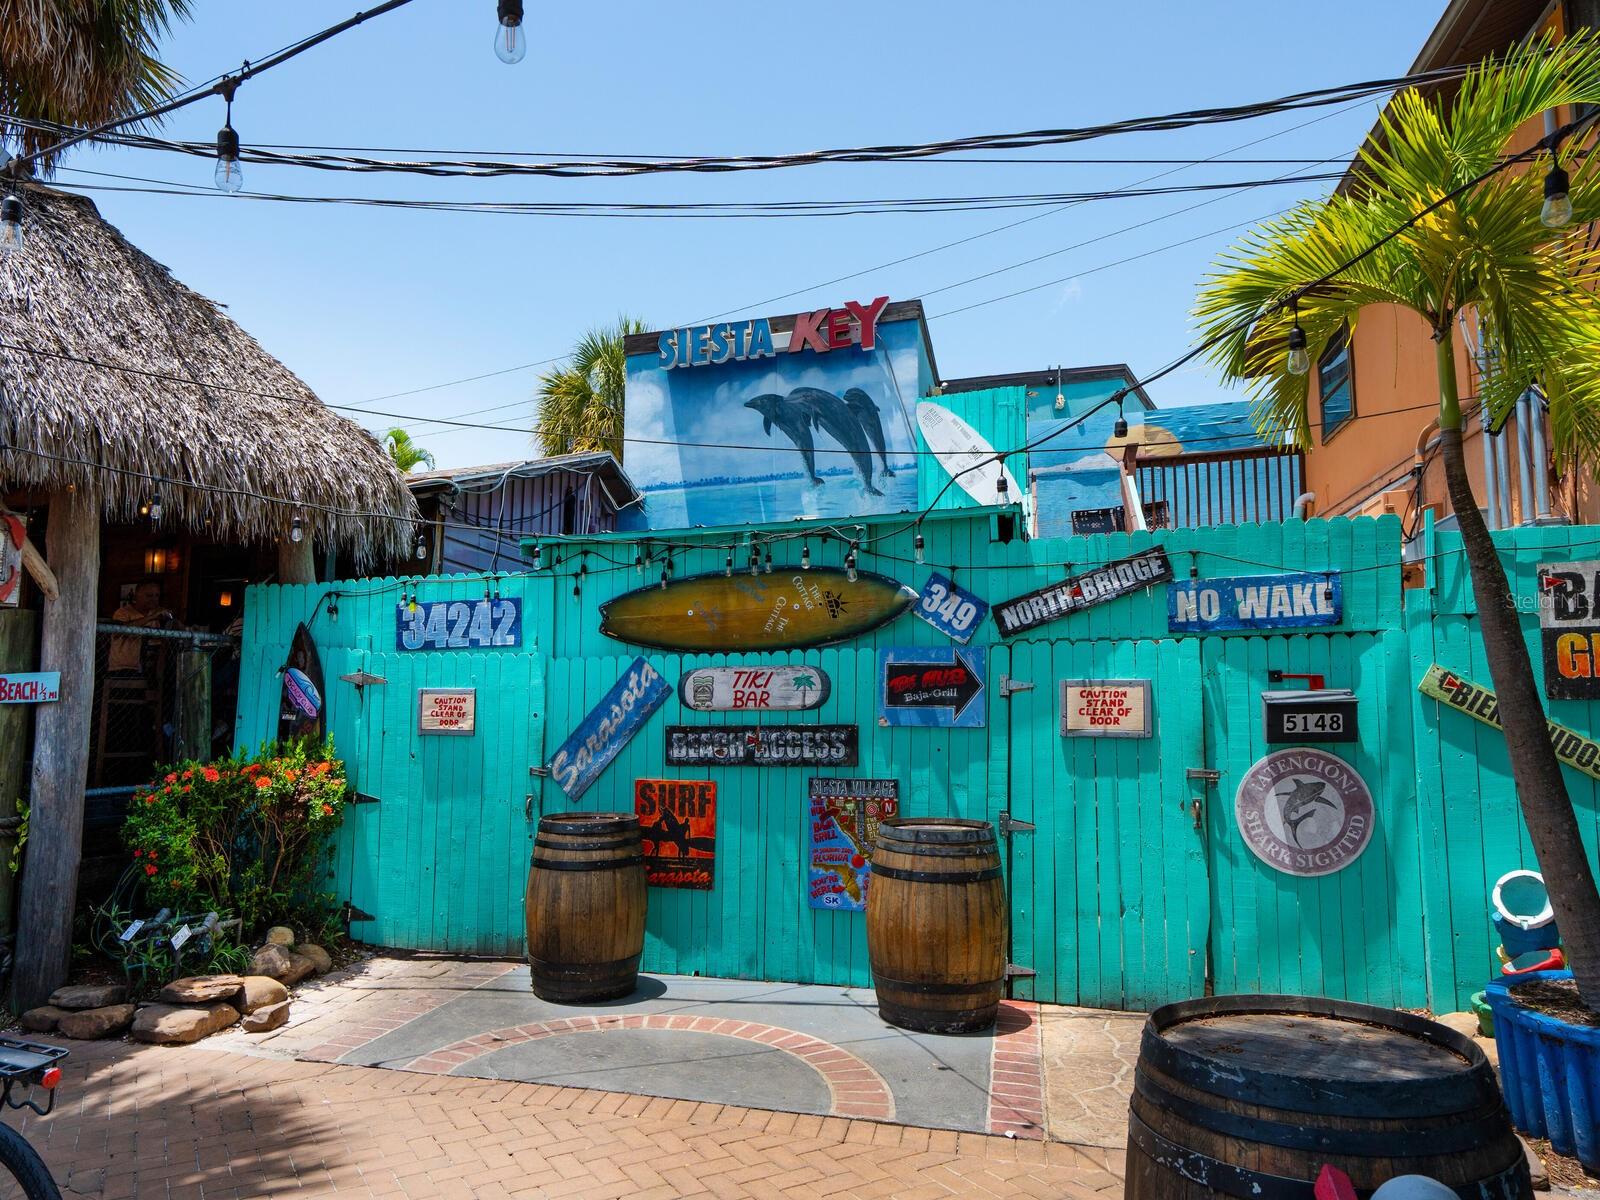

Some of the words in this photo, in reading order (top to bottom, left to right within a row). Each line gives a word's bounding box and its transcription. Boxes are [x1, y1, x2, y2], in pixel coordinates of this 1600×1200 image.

[658, 316, 776, 370] SIESTA
[787, 295, 890, 353] KEY
[792, 575, 815, 611] COTTAGE
[808, 582, 822, 602] THE
[1001, 585, 1072, 631] NORTH
[1082, 551, 1167, 602] BRIDGE
[1552, 571, 1600, 621] B
[921, 583, 977, 631] 349
[1176, 588, 1221, 624] NO
[1237, 581, 1335, 620] WAKE
[763, 596, 787, 633] COTTAGE
[402, 600, 517, 650] 34242
[775, 616, 790, 633] THE
[1556, 632, 1600, 679] G
[732, 671, 775, 689] TIKI
[922, 668, 968, 687] HUB
[0, 677, 38, 700] BEACH
[904, 687, 959, 703] Baja-Grill
[1079, 689, 1128, 699] CAUTION
[434, 696, 467, 705] CAUTION
[438, 704, 463, 712] STAND
[732, 690, 771, 708] BAR
[1086, 699, 1125, 708] STAND
[430, 710, 455, 718] CLEAR
[456, 711, 467, 719] OF
[1078, 707, 1114, 716] CLEAR
[1116, 707, 1133, 717] OF
[1089, 716, 1121, 726] DOOR
[439, 719, 459, 727] DOOR
[552, 663, 660, 792] Sarasota
[1285, 714, 1342, 732] 5148
[672, 732, 746, 760] BEACH
[753, 731, 846, 760] ACCESS
[811, 780, 848, 796] SIESTA
[851, 780, 896, 798] VILLAGE
[639, 783, 712, 818] SURF
[1245, 809, 1293, 866] SHARK
[1295, 814, 1365, 868] SIGHTED
[644, 865, 711, 885] arasota
[824, 896, 839, 905] SK
